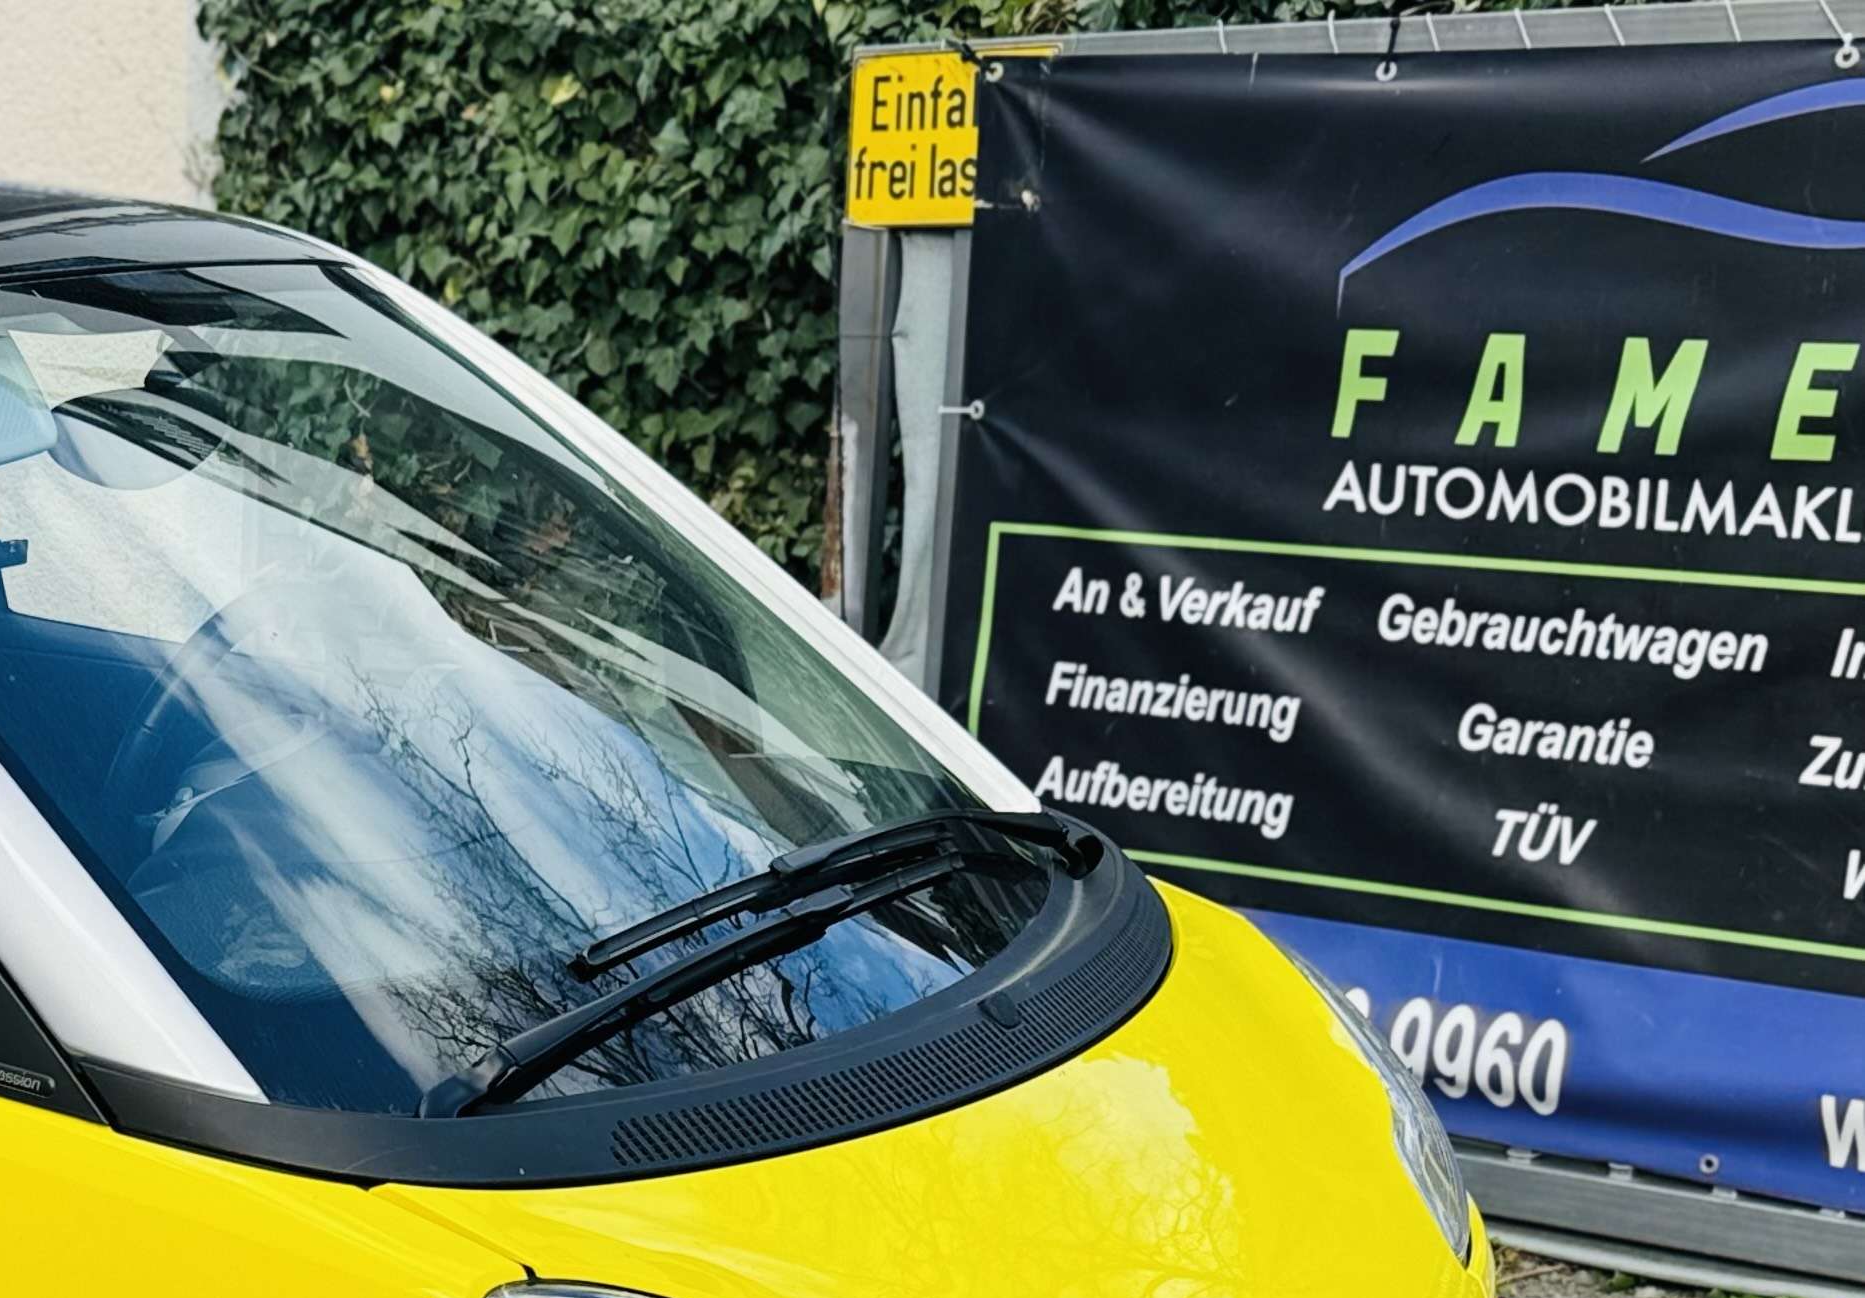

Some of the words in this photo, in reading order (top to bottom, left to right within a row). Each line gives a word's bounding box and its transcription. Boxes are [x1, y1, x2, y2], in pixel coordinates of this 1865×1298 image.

[855, 144, 917, 200] frei
[928, 144, 976, 199] las
[1331, 328, 1861, 462] FAME
[1052, 566, 1110, 615] An
[1119, 572, 1146, 618] &
[1158, 575, 1326, 634] Verkauf
[1377, 592, 1769, 680] Gebrauchtwagen
[1045, 660, 1301, 743] Finanzierung
[1458, 702, 1654, 768] Garantie
[1034, 755, 1294, 840] Aufbereitung
[1491, 801, 1598, 866] TÜV
[1390, 996, 1567, 1116] 9960
